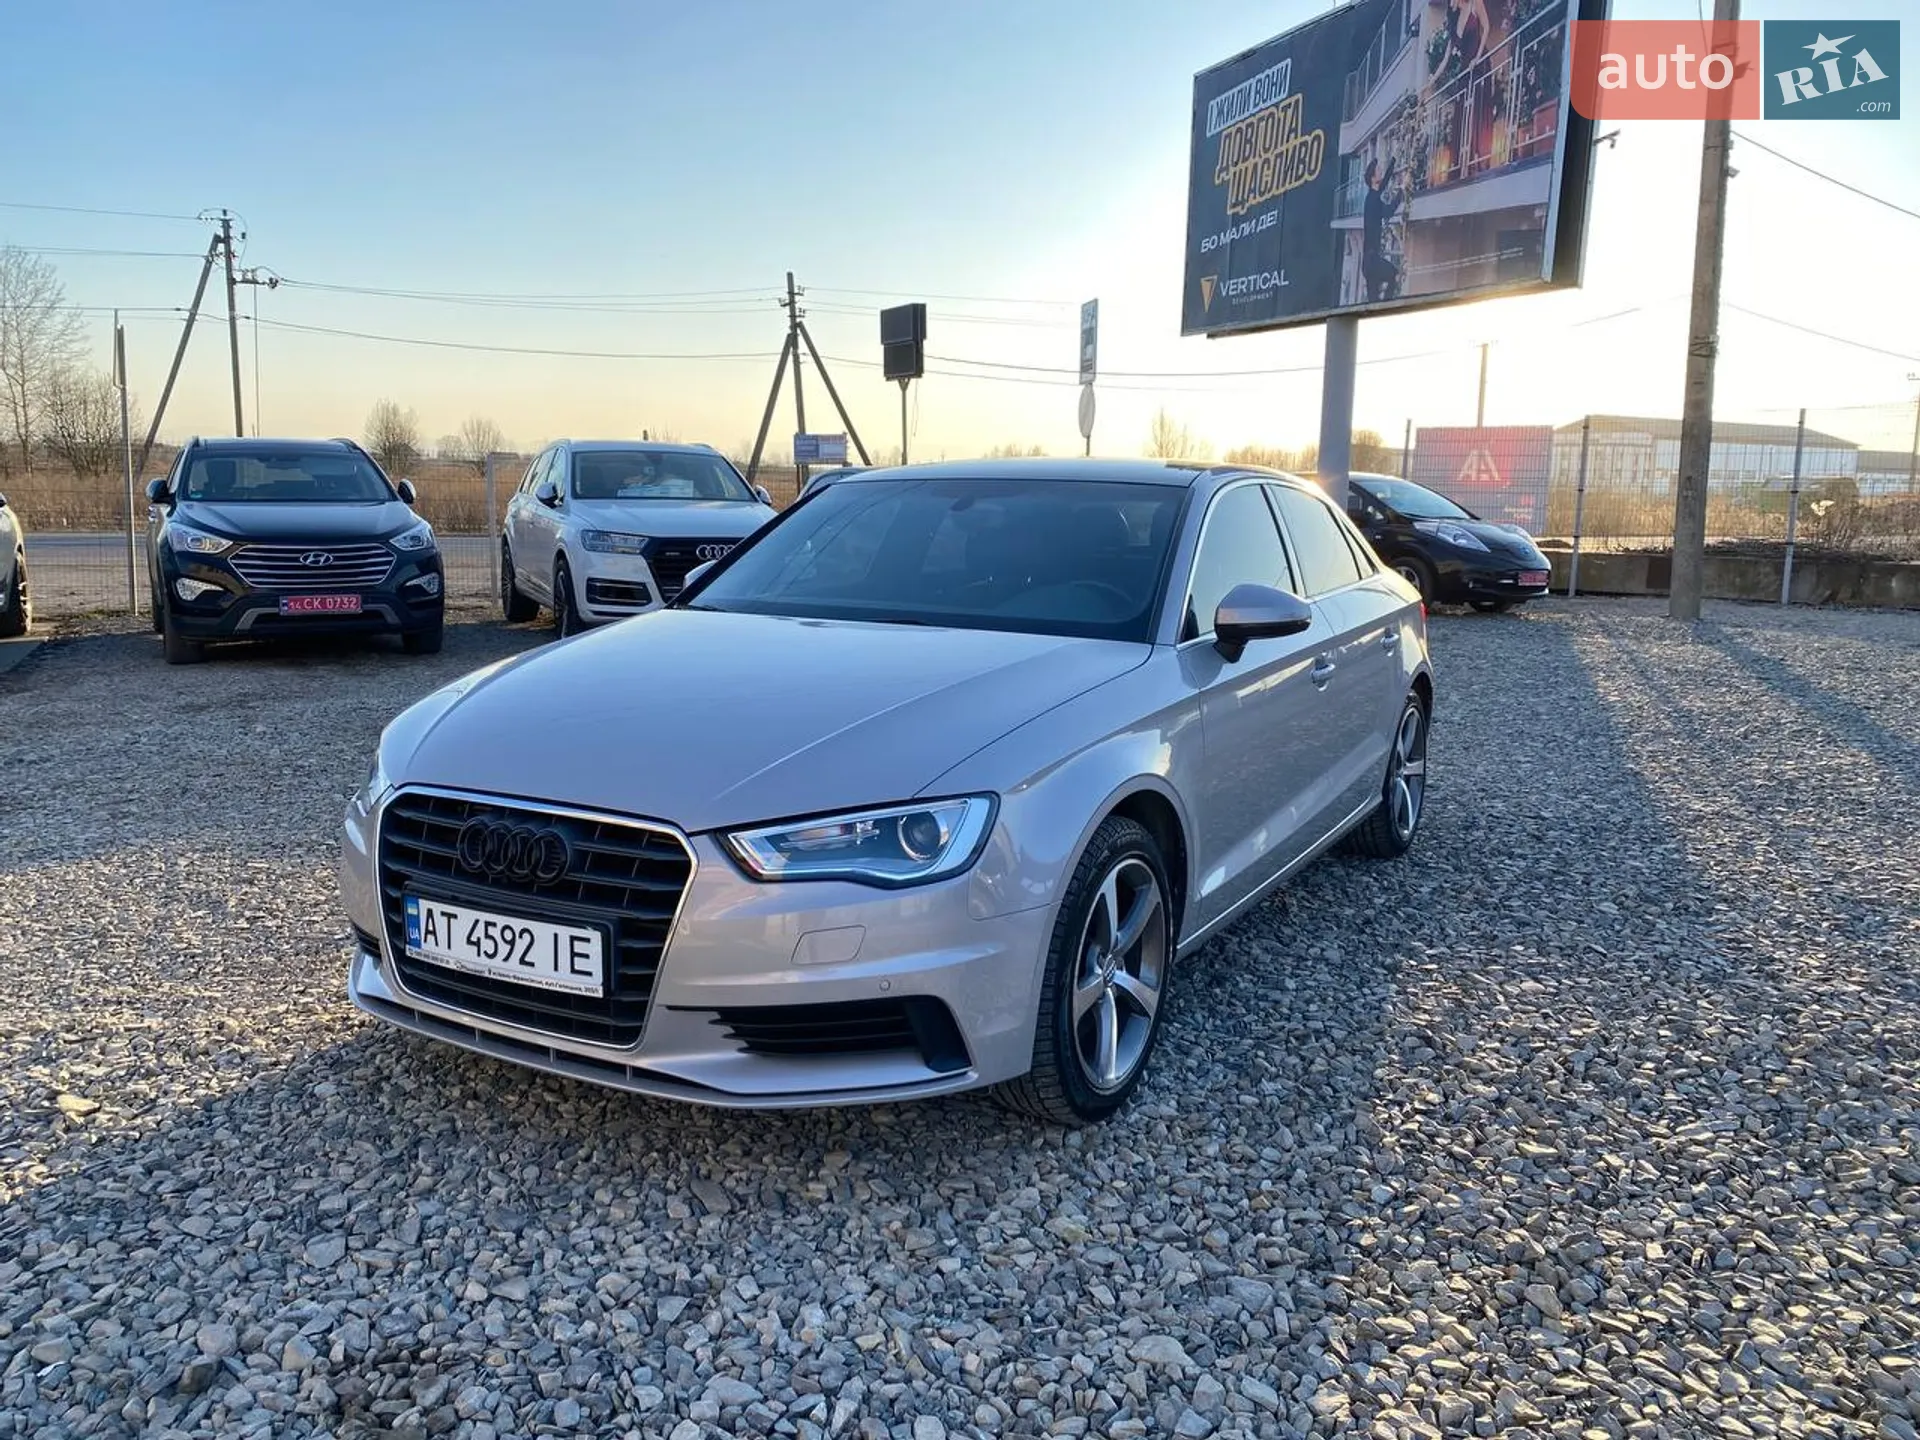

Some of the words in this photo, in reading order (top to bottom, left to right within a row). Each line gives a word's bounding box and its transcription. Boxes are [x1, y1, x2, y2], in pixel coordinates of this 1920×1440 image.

[1213, 80, 1252, 128] ЖИЛИ
[1254, 62, 1291, 108] ВОНИ
[1228, 133, 1323, 211] ЩАСЛИВО
[1201, 235, 1218, 253] БО
[1219, 219, 1256, 247] МАЛИ
[1257, 209, 1278, 233] ДЕ!
[1220, 269, 1289, 297] VERTICAL
[303, 598, 322, 609] CK
[326, 597, 358, 609] 0732
[409, 926, 420, 940] UA
[423, 907, 459, 950] AT
[466, 918, 536, 968] 4592
[553, 932, 594, 977] IE
